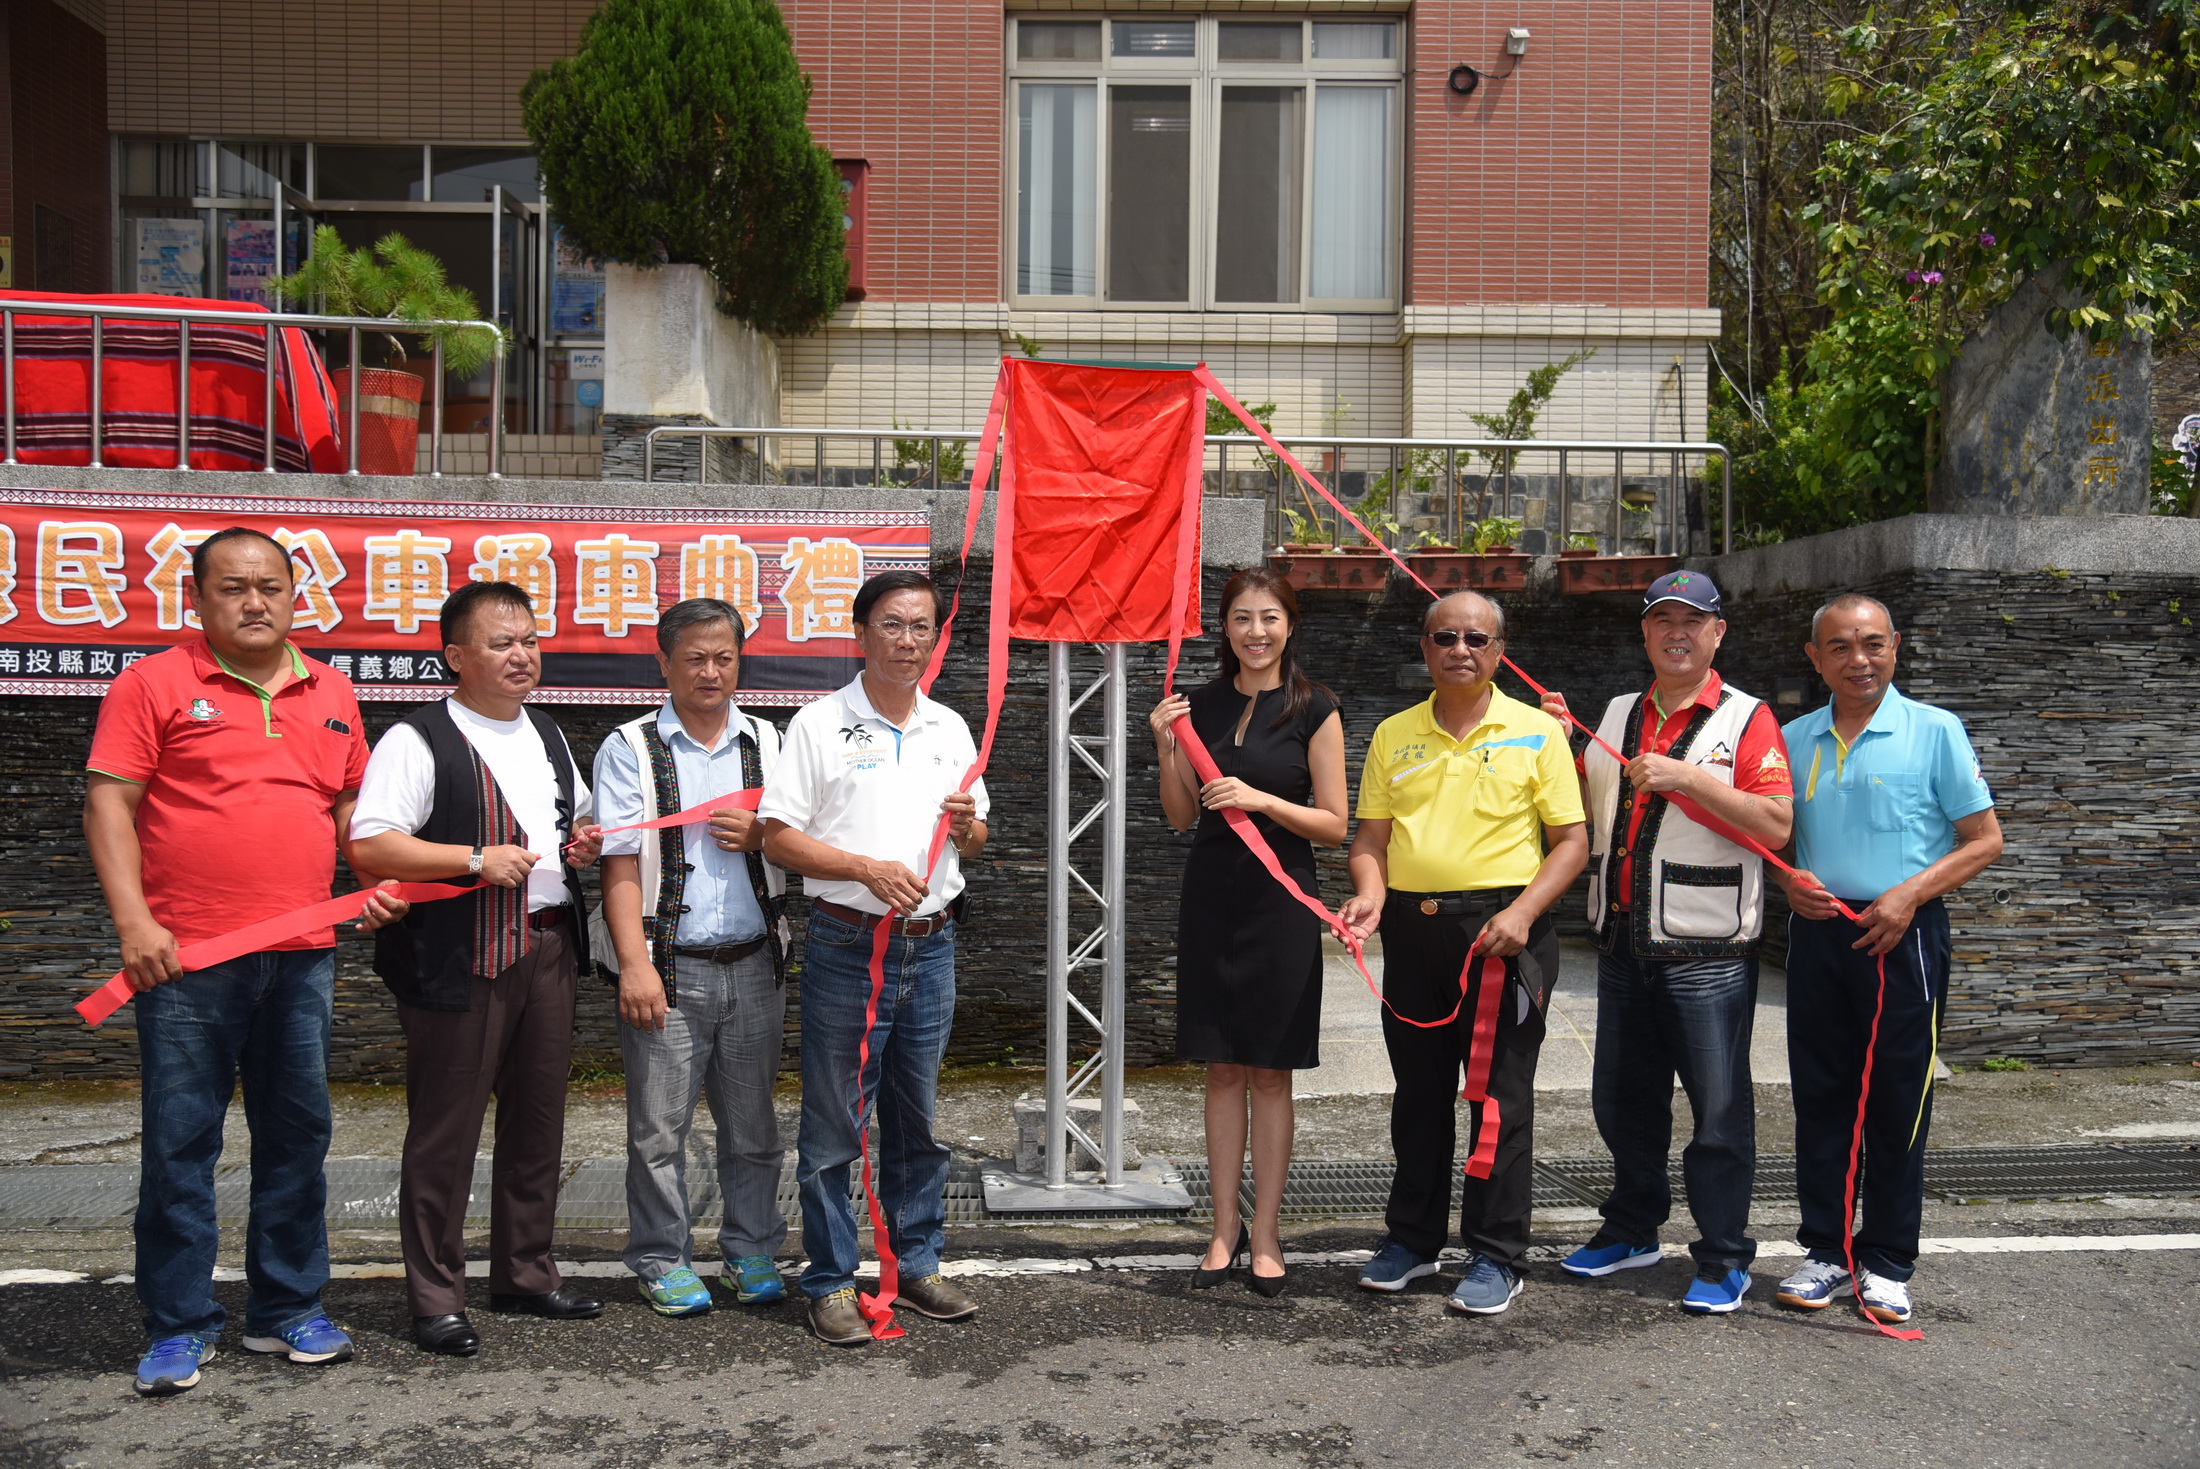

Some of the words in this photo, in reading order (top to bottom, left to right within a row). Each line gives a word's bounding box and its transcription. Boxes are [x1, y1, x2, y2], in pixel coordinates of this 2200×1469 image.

[574, 355, 602, 363] Wi-Fi
[328, 654, 451, 681] 信義鄉公
